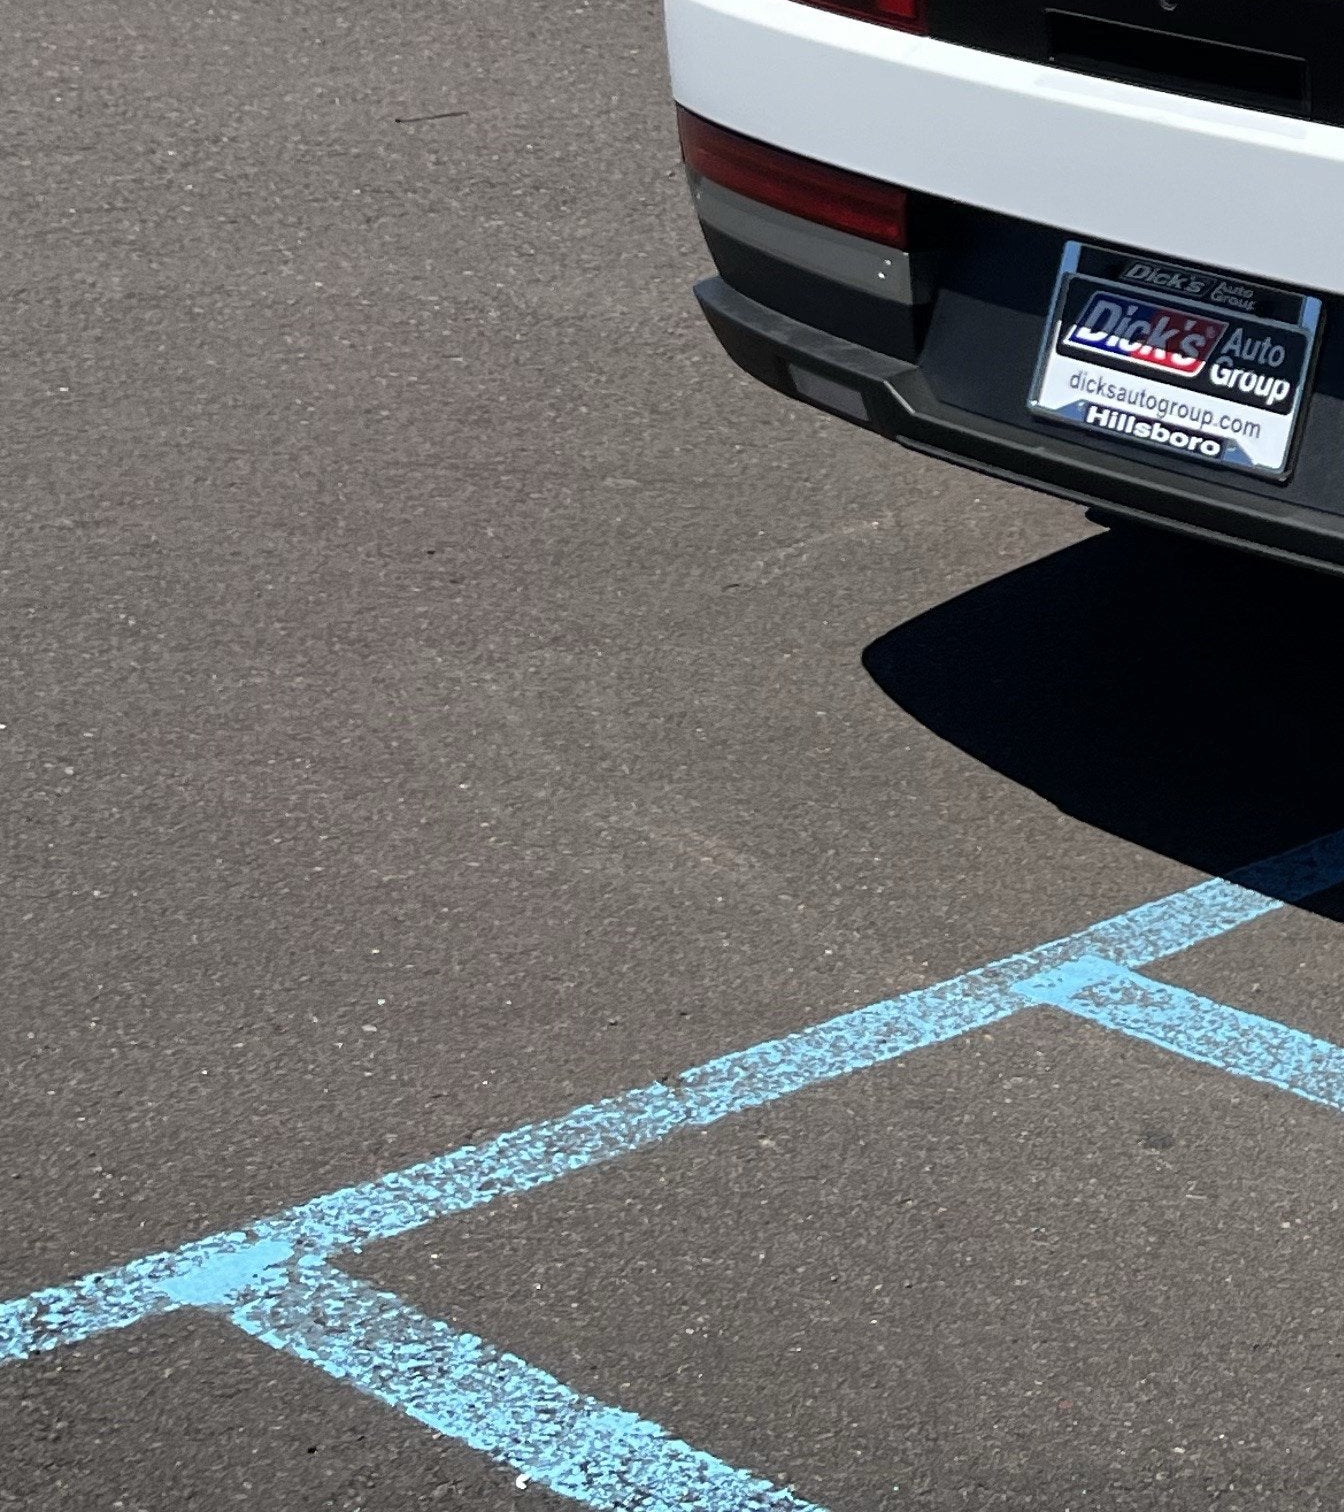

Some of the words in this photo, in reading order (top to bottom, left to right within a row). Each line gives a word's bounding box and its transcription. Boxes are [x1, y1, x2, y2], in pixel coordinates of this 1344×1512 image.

[1124, 263, 1206, 293] Dick's
[1076, 299, 1206, 367] Dick's
[1220, 327, 1286, 368] Auto
[1069, 370, 1262, 439] dicksautogroup.com
[1210, 355, 1291, 406] Group
[1086, 405, 1222, 457] Hillsboro
